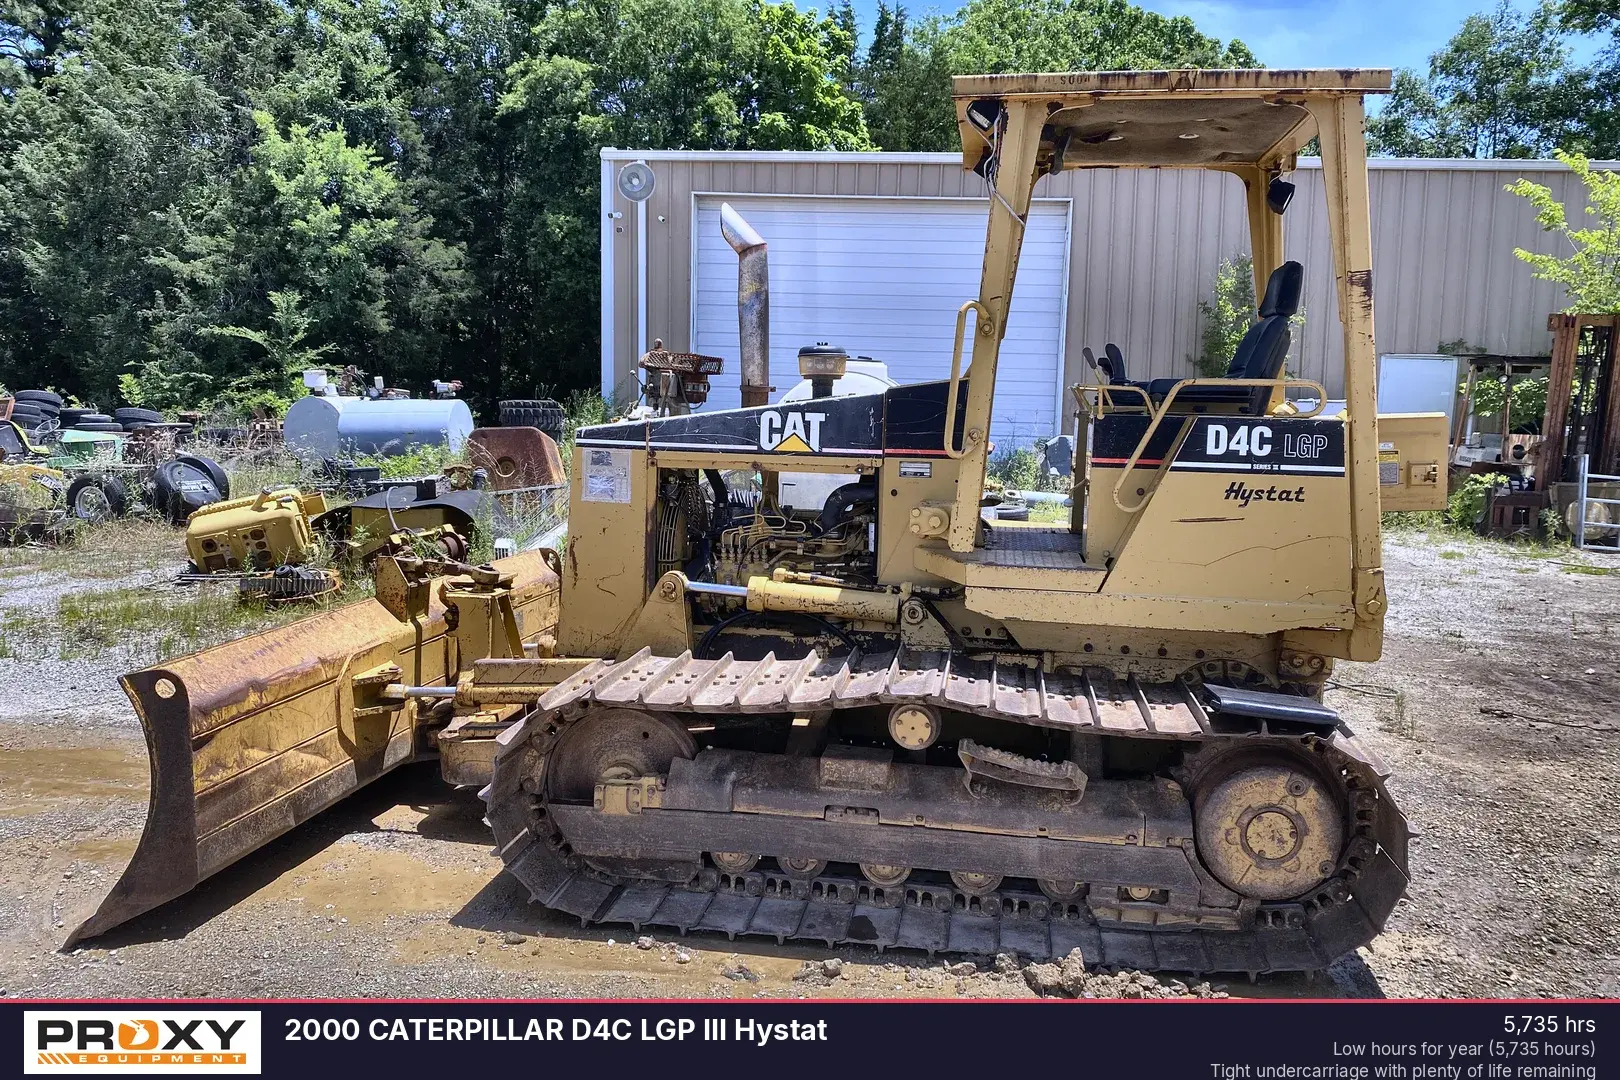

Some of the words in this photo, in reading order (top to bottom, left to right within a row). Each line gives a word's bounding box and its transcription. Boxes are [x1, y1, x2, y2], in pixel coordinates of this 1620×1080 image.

[760, 410, 826, 452] CAT
[1206, 424, 1272, 457] D4C
[1283, 433, 1328, 458] LGP
[1224, 481, 1305, 508] Hystat
